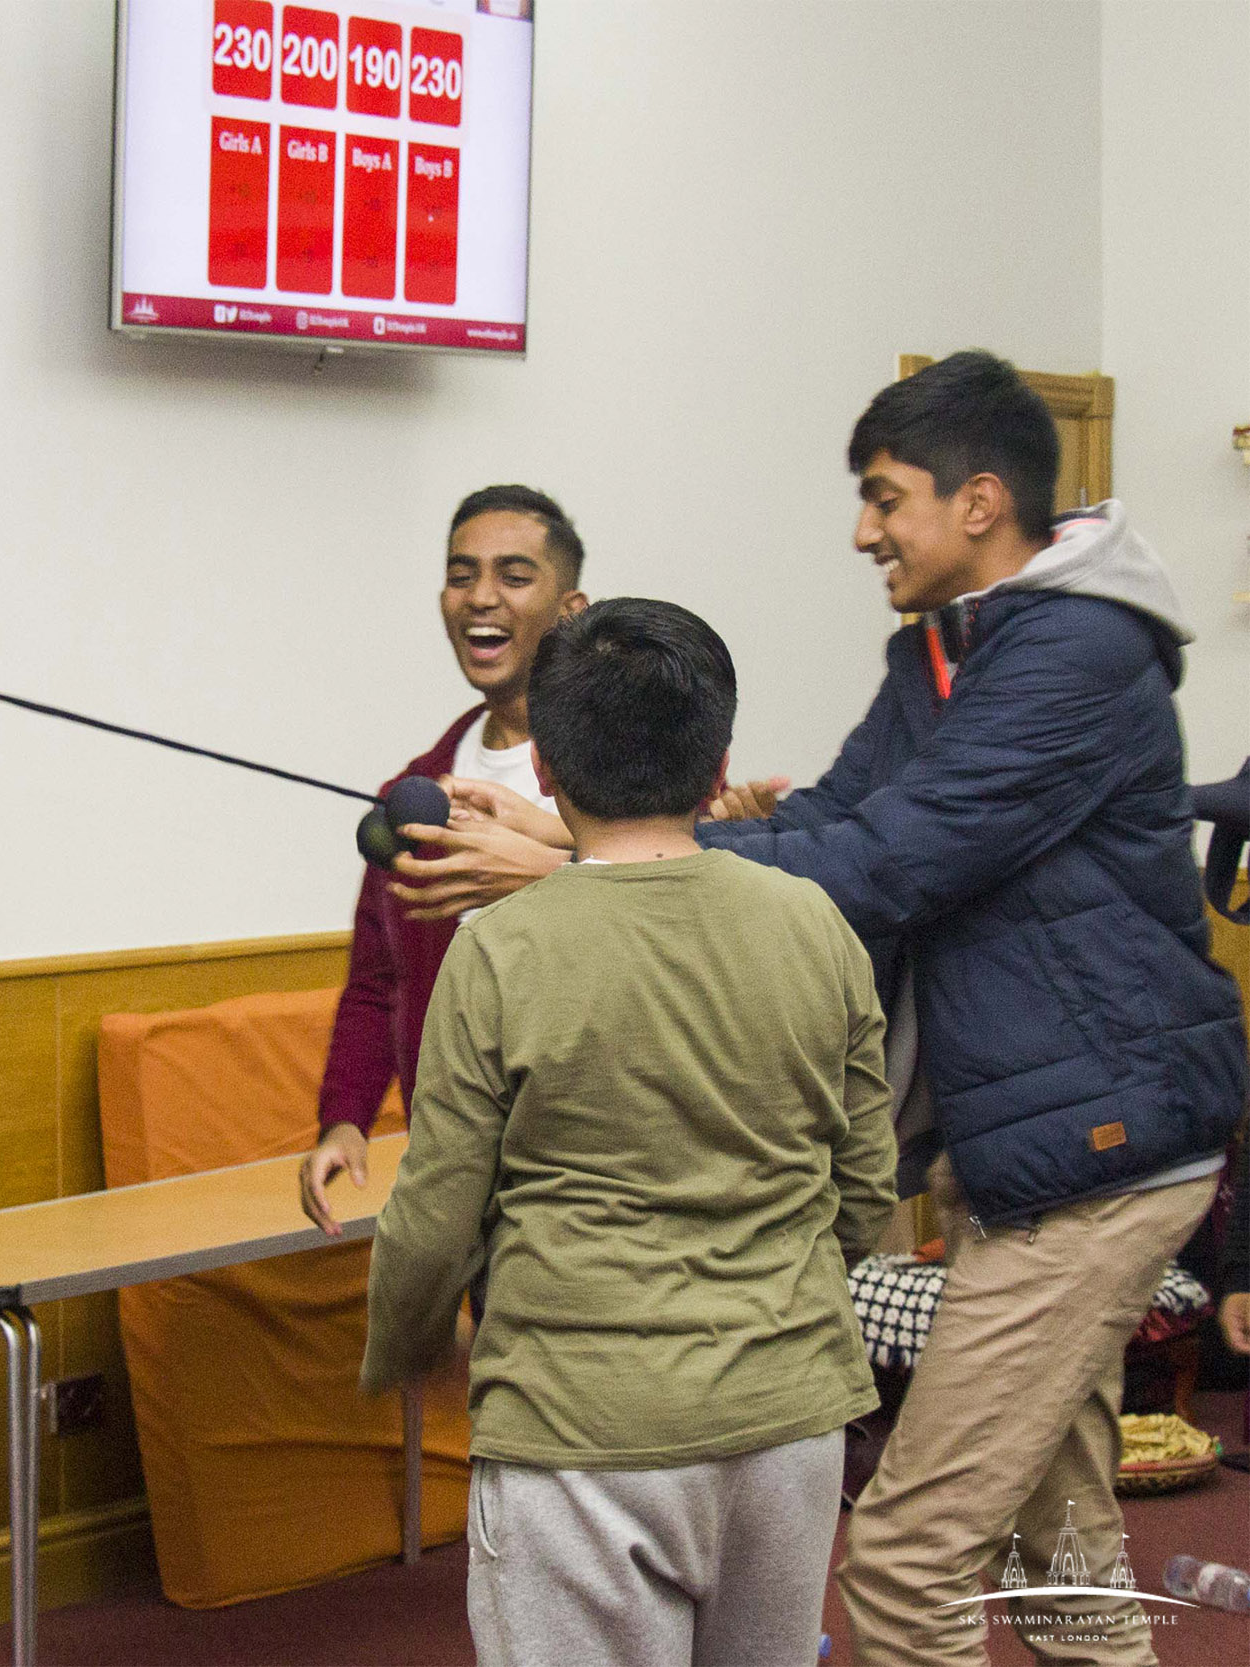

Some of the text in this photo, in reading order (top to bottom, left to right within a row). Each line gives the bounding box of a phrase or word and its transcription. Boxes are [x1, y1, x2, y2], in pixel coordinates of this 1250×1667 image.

[213, 22, 272, 72] 230
[282, 32, 337, 81] 200
[349, 44, 400, 90] 190
[410, 54, 462, 100] 230
[219, 131, 262, 155] Girls A
[287, 139, 329, 163] Girls B
[352, 147, 392, 173] Boys A
[414, 155, 453, 180] Boys B
